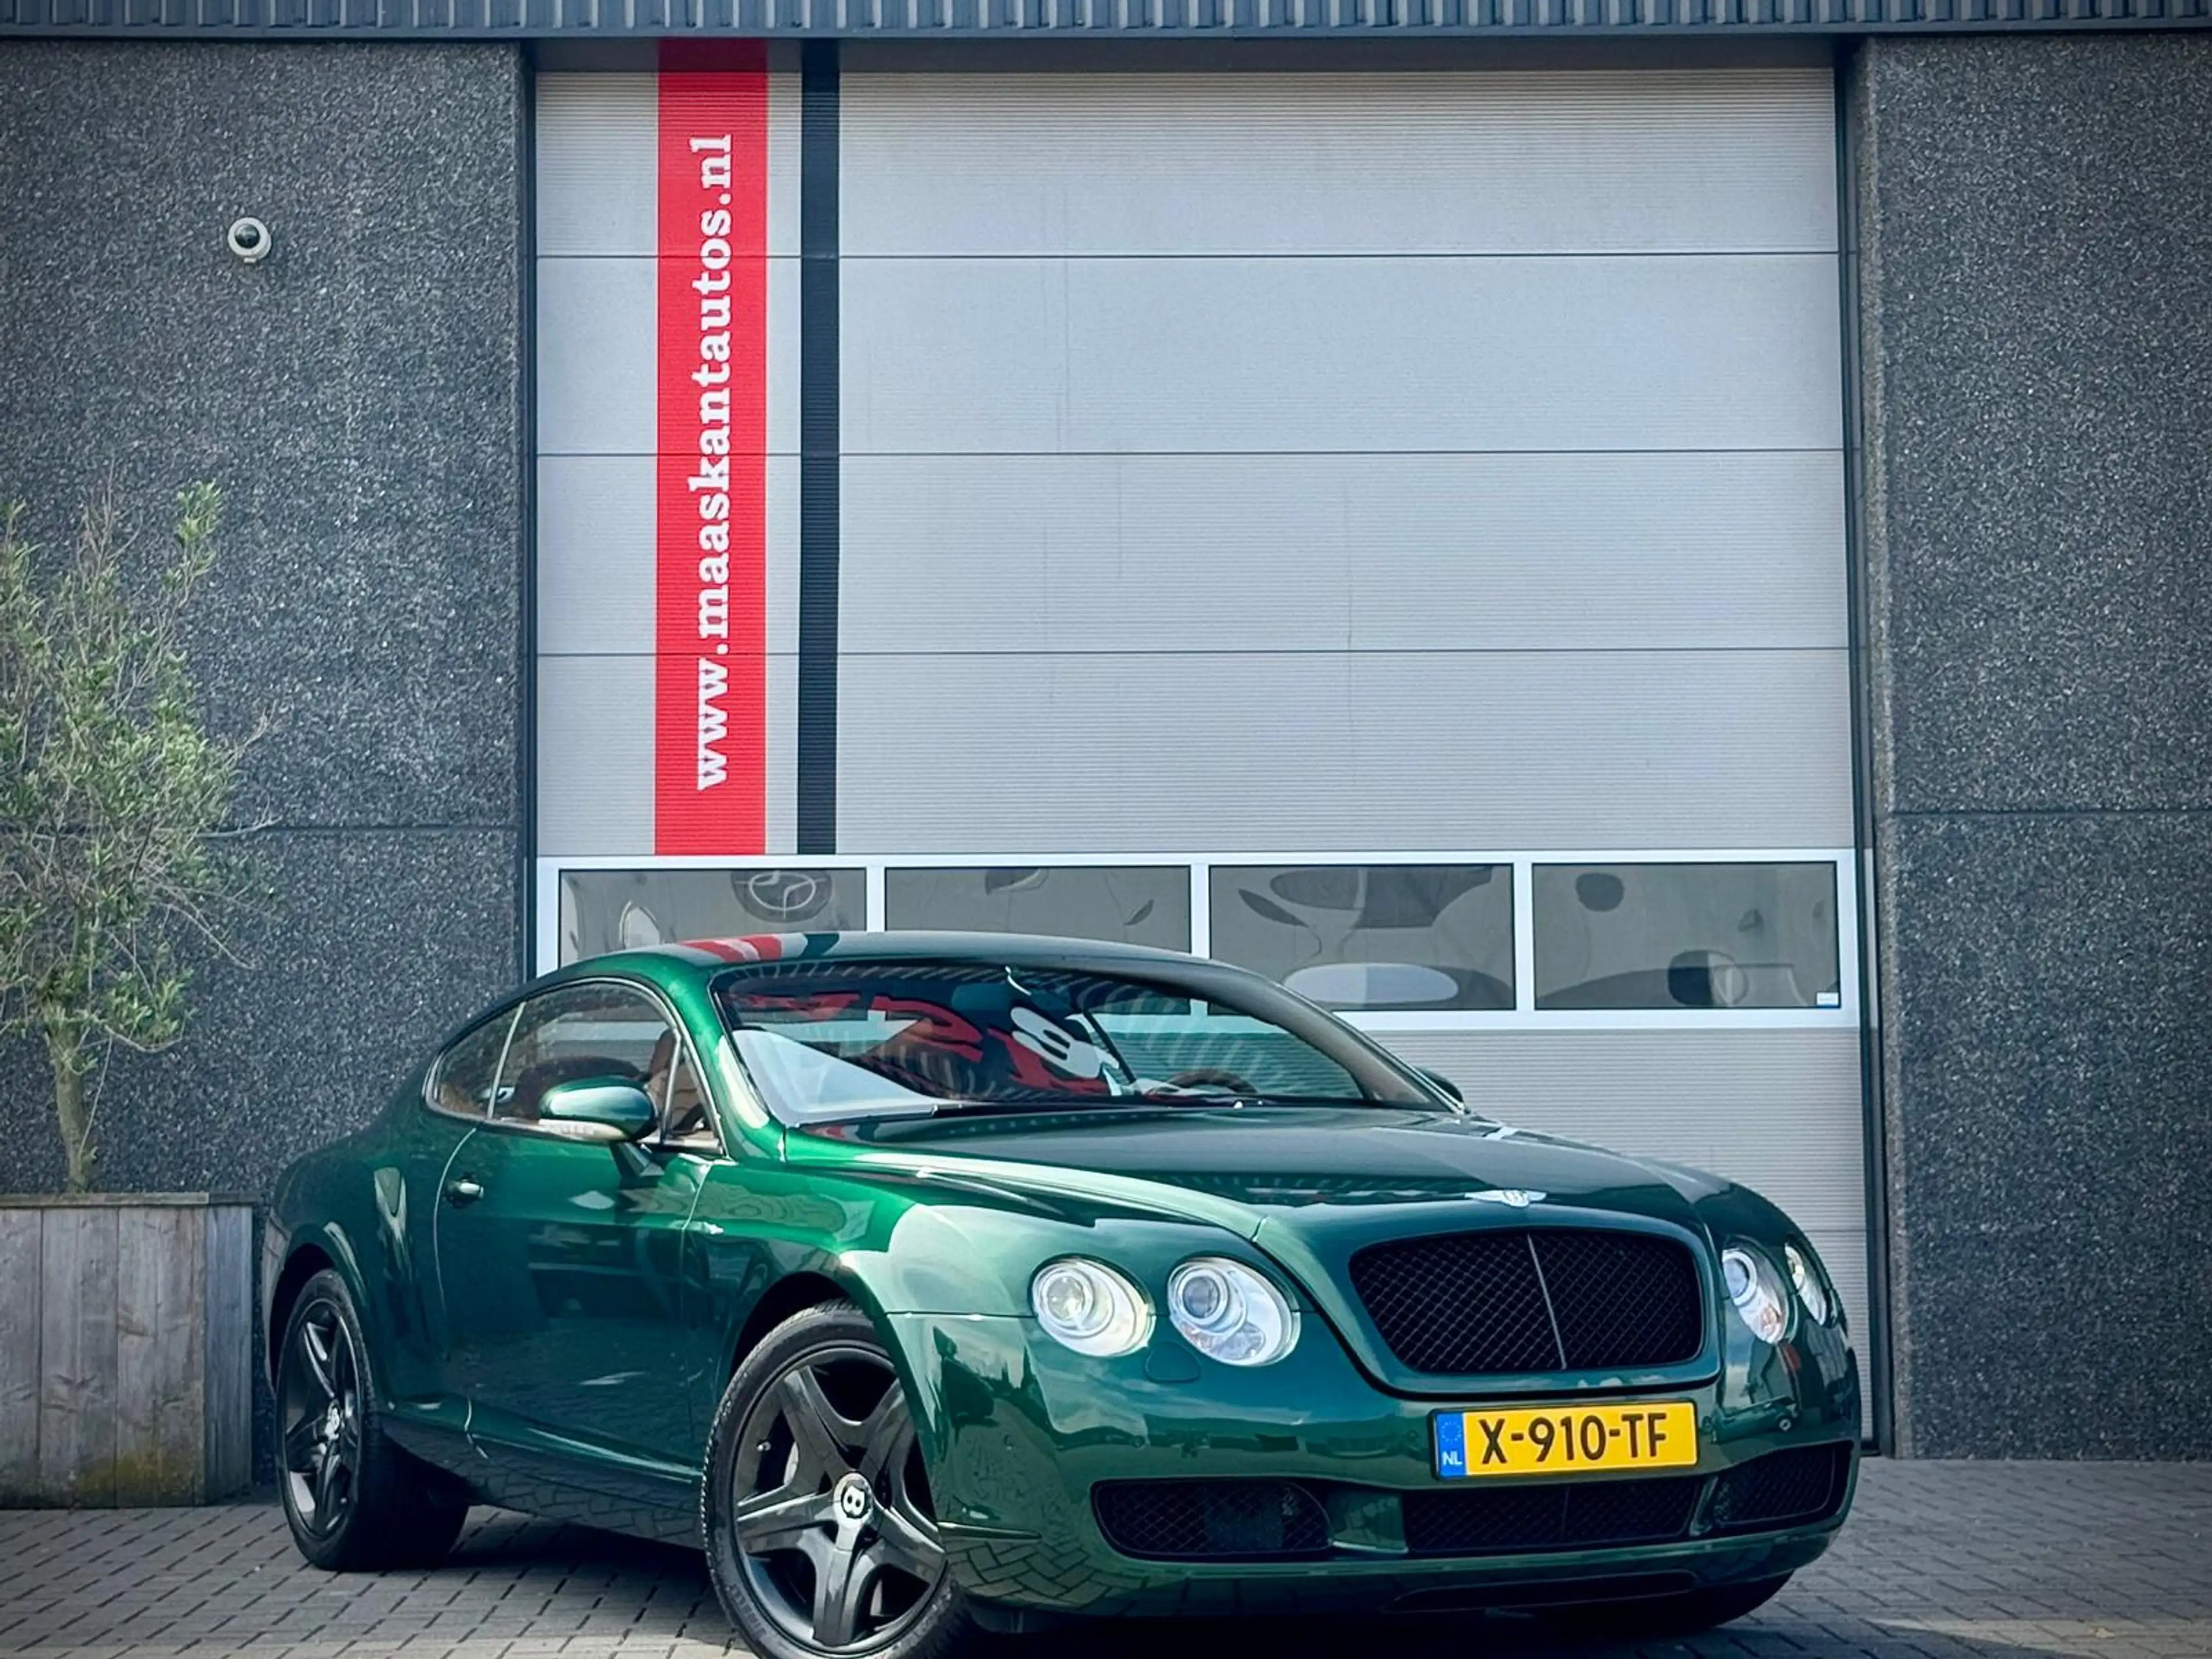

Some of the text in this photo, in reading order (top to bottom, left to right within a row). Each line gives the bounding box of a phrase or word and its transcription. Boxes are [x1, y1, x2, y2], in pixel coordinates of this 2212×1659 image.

[687, 134, 732, 790] www.maaskantautos.nl
[1442, 1413, 1666, 1465] NL X-910-TF
